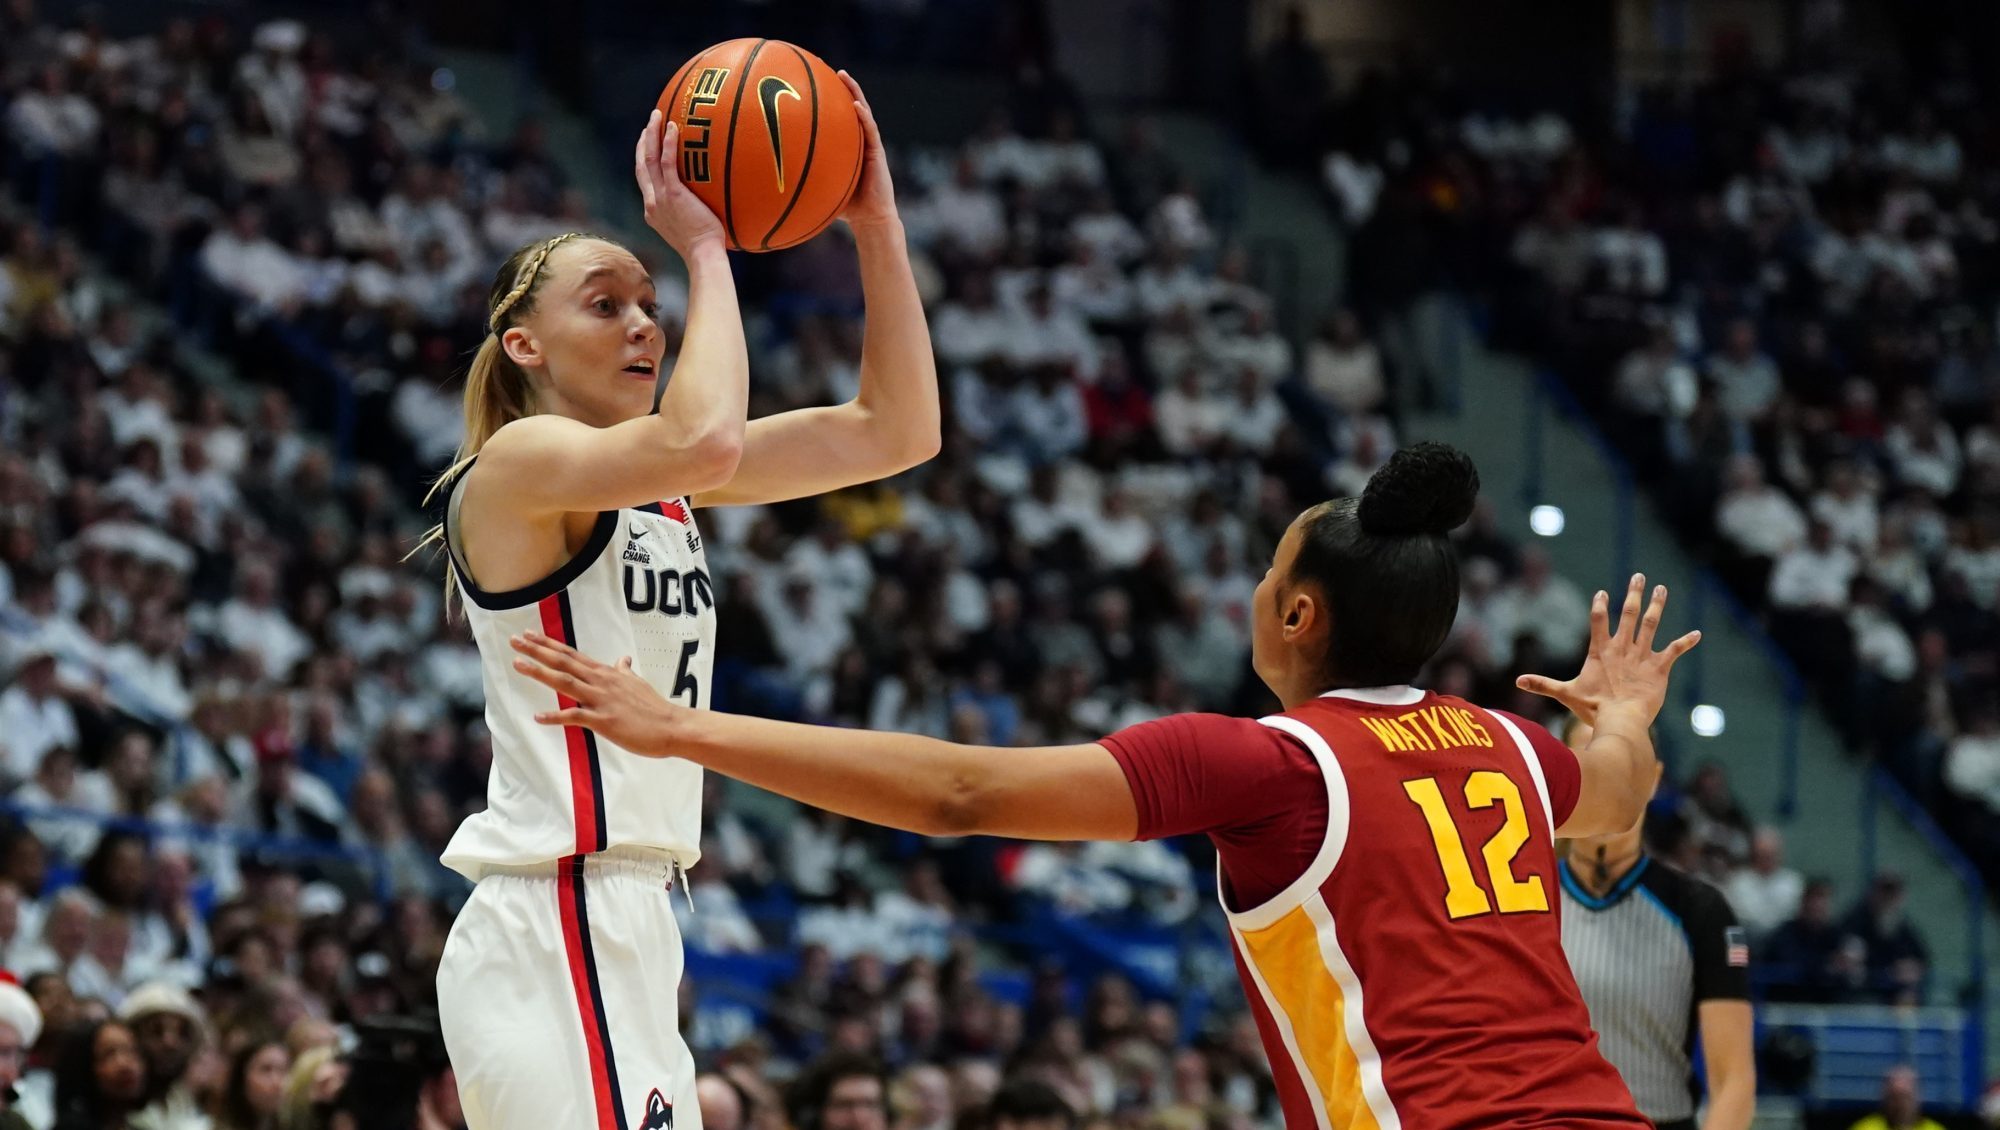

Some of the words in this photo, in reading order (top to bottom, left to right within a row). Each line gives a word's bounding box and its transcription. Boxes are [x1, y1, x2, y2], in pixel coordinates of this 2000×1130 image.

[684, 67, 731, 184] ELITE
[622, 549, 650, 565] CHANGE
[670, 639, 700, 709] 5
[1359, 705, 1494, 752] WATKINS
[1402, 770, 1550, 921] 12
